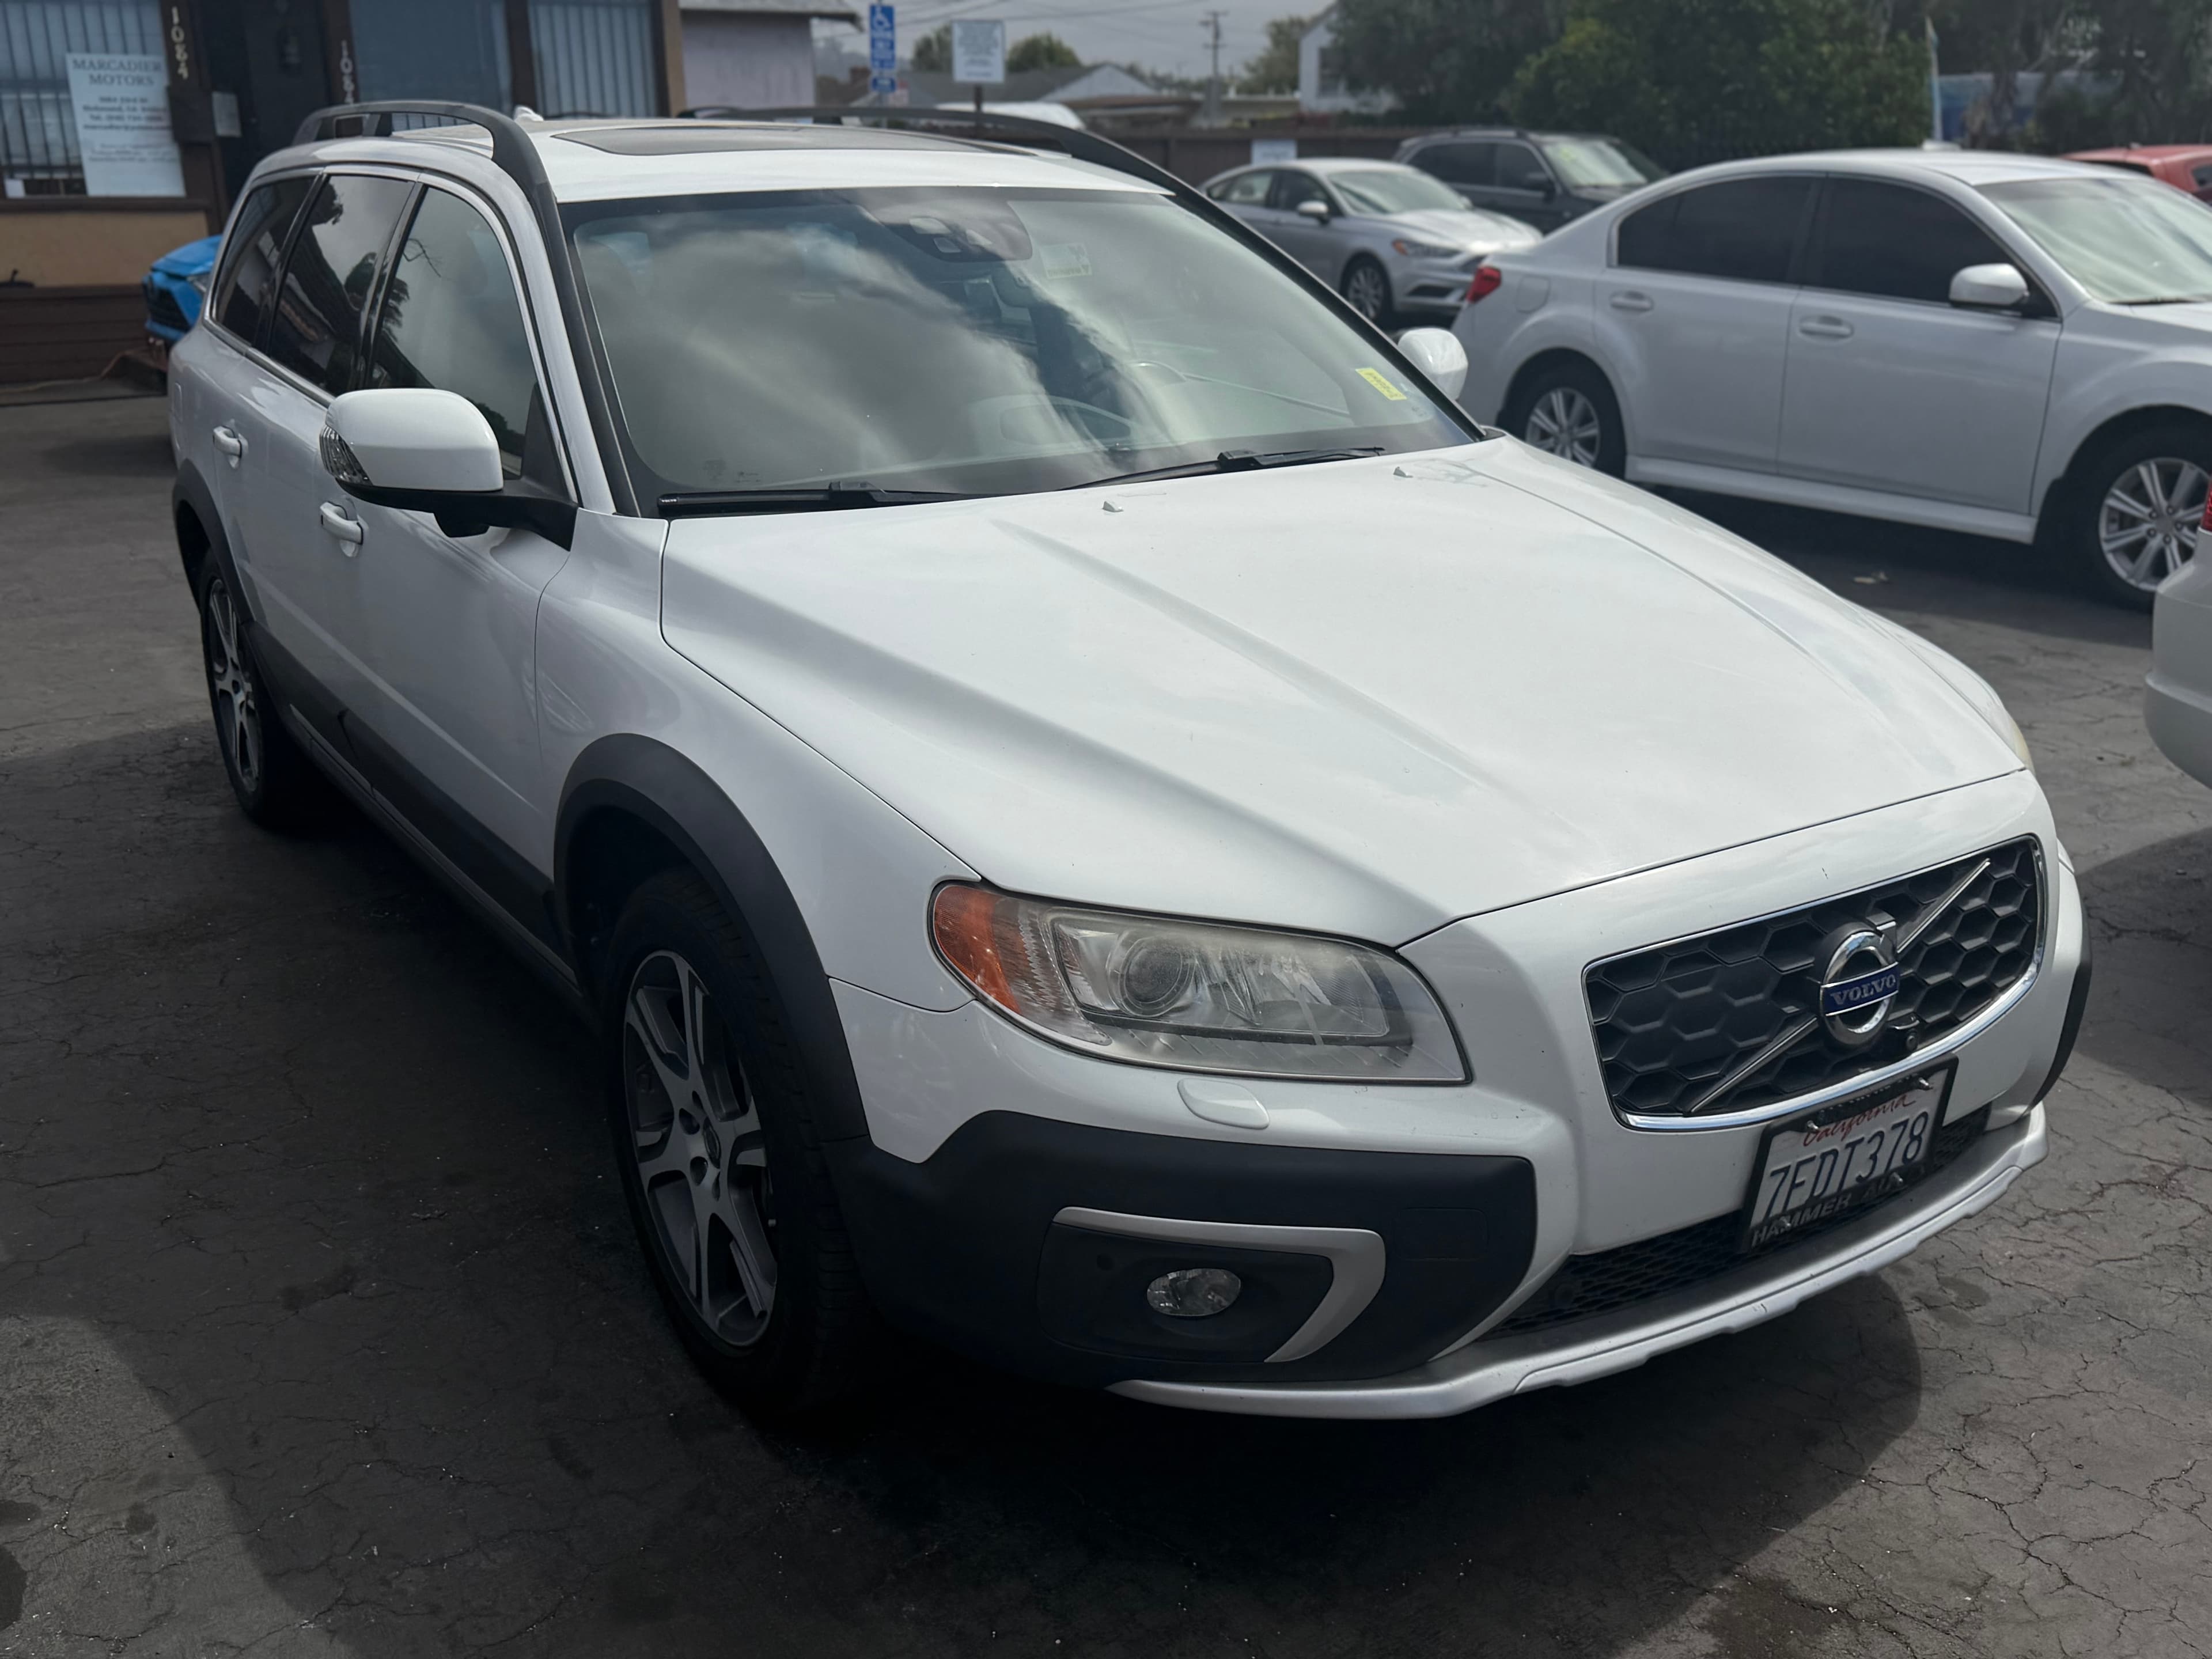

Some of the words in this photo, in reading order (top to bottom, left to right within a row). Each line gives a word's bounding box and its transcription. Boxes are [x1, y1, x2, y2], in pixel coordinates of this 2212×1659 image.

[73, 59, 162, 73] MARCADIER
[88, 73, 155, 86] MOTORS
[1830, 974, 1896, 1005] VOLVO
